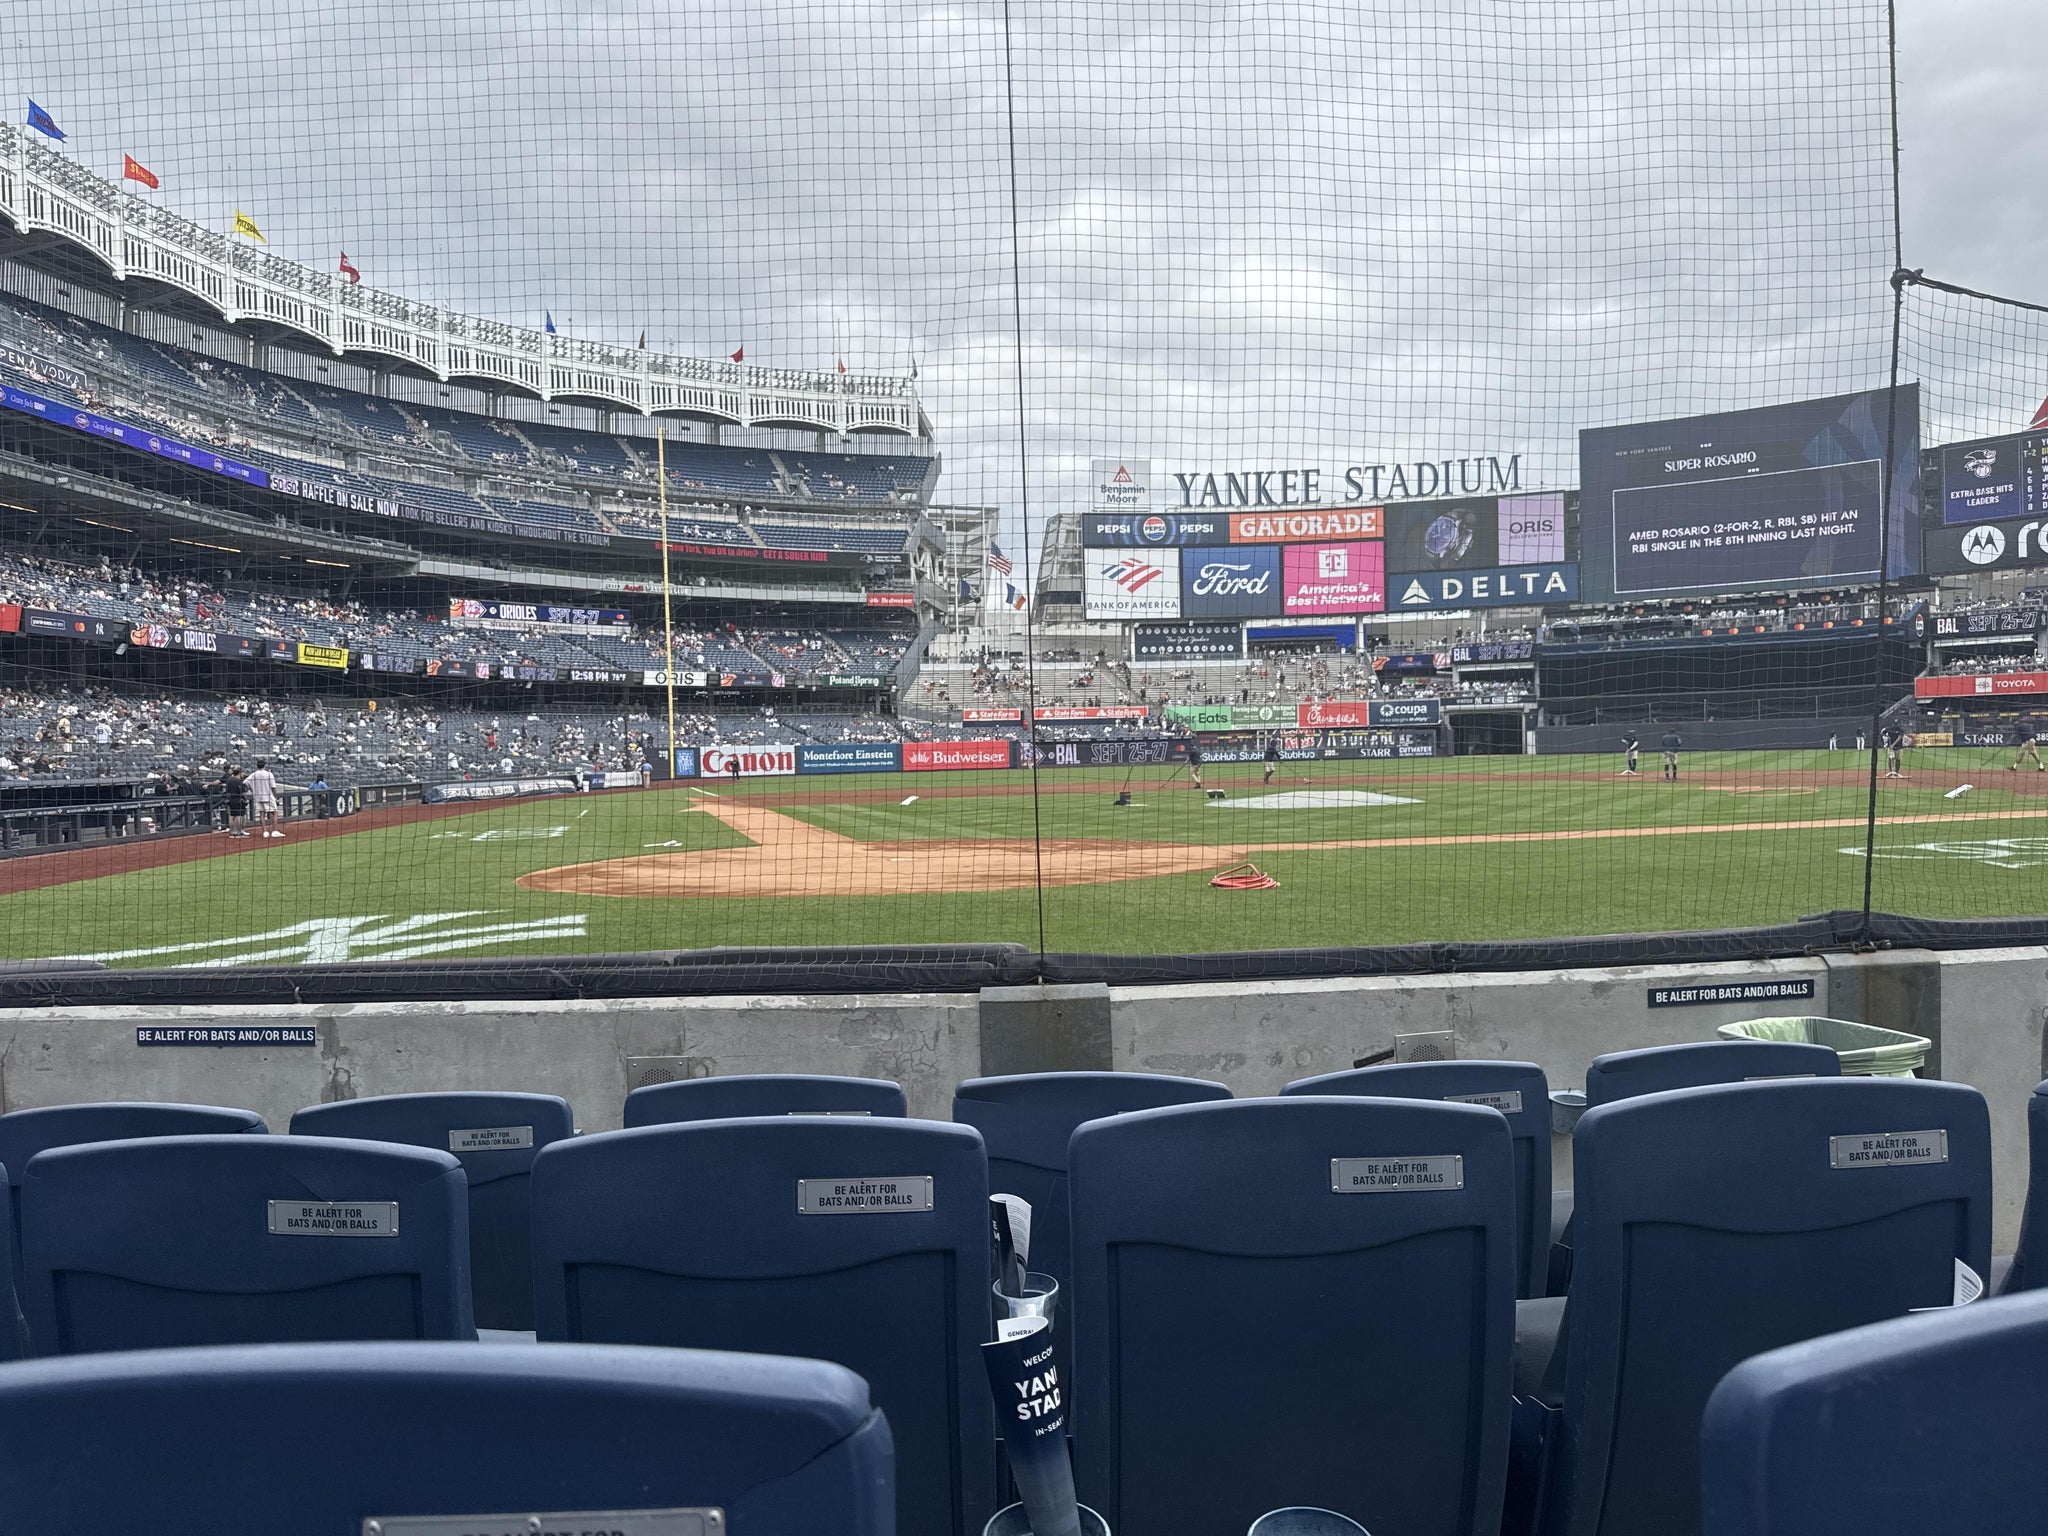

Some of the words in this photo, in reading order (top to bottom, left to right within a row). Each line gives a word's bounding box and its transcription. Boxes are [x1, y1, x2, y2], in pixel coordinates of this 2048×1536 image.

[1665, 458, 1701, 472] SUPER
[1705, 451, 1757, 468] ROSARIO
[2027, 467, 2032, 475] 4
[1173, 468, 1321, 507] YANKEE
[1345, 455, 1521, 501] STADIUM
[2027, 476, 2032, 484] 5
[1101, 484, 1145, 497] Benjamin
[1951, 489, 1974, 499] EXTRA
[1975, 486, 1995, 496] BASE
[1996, 484, 2013, 494] HITS
[2027, 485, 2033, 493] 6
[302, 482, 334, 504] RAFFLE
[337, 490, 349, 508] ON
[351, 494, 374, 513] SALE
[377, 499, 399, 517] NOW
[1106, 495, 1138, 504] Moore
[1966, 495, 2000, 507] LEADERS
[401, 505, 419, 520] LOOK
[421, 511, 434, 523] FOR
[436, 513, 468, 528] SELLERS
[471, 518, 485, 531] AND
[488, 521, 513, 535] KIOSKS
[515, 524, 562, 542] THROUGHOUT
[564, 533, 578, 543] THE
[579, 534, 610, 547] STADIUM
[1097, 524, 1130, 534] PEPSI
[1180, 523, 1213, 533] PEPSI
[1239, 512, 1377, 537] GATORADE
[1510, 519, 1553, 534] ORIS
[1628, 529, 1659, 541] AMED
[1662, 524, 1710, 538] ROSARIO
[1713, 519, 1761, 534] (2-FOR-2,
[1778, 516, 1797, 529] RBI,
[1800, 513, 1817, 526] SB)
[1821, 511, 1838, 522] HIT
[1840, 509, 1858, 520] AN
[1632, 543, 1648, 553] RBI
[1651, 539, 1687, 552] SINGLE
[1690, 538, 1701, 548] IN
[1704, 536, 1722, 547] THE
[1725, 534, 1744, 546] 8TH
[1747, 531, 1787, 545] INNING
[1790, 528, 1816, 540] LAST
[1819, 523, 1855, 536] NIGHT.
[763, 550, 777, 560] GET
[1192, 563, 1271, 595] Ford
[1298, 582, 1369, 595] America's
[1442, 571, 1567, 600] DELTA
[1087, 602, 1115, 610] BANK
[1117, 602, 1130, 610] OF
[1131, 600, 1177, 610] AMERICA
[1287, 595, 1318, 606] Best
[1320, 592, 1380, 605] Network
[500, 604, 537, 621] ORIOLES
[549, 607, 571, 624] SEPT
[573, 609, 600, 625] 25-27
[1937, 618, 1959, 634] BAL
[1968, 614, 1998, 633] SEPT
[2001, 611, 2037, 629] 25-27
[184, 631, 217, 652] ORIOLES
[1453, 648, 1471, 661] BAL
[1479, 646, 1502, 660] SEPT
[1504, 644, 1532, 660] 25-27
[571, 670, 593, 681] 12:58
[596, 671, 608, 682] PM
[655, 672, 694, 685] ORIS
[829, 675, 855, 686] Poland
[855, 676, 879, 687] Spring
[1995, 680, 2036, 688] TOYOTA
[979, 711, 998, 719] State
[1106, 709, 1124, 717] State
[1124, 708, 1141, 716] Farm
[1394, 704, 1427, 716] coupa
[1198, 713, 1228, 724] Eats
[1964, 733, 2004, 744] STARR
[804, 750, 853, 761] Montefiore
[855, 749, 894, 760] Einstein
[932, 752, 1005, 764] Budweiser
[1056, 744, 1080, 764] BAL
[1091, 744, 1124, 764] SEPT
[1128, 742, 1168, 762] 25-27
[1202, 753, 1236, 762] StubHub
[1239, 751, 1264, 760] StubH
[1280, 751, 1315, 759] StubHub
[1360, 748, 1390, 757] STARR
[702, 750, 793, 774] Canon
[1656, 992, 1668, 1003] BE
[1670, 989, 1697, 1001] ALERT
[1699, 988, 1717, 999] FOR
[1718, 986, 1742, 998] BATS
[1742, 984, 1778, 997] AND/OR
[1780, 983, 1808, 995] BALLS
[139, 1030, 152, 1041] BE
[154, 1030, 185, 1041] ALERT
[188, 1030, 207, 1041] FOR
[210, 1030, 236, 1041] BATS
[238, 1030, 280, 1041] AND/OR
[282, 1030, 314, 1041] BALLS
[1863, 1141, 1874, 1150] BE
[1876, 1139, 1900, 1149] ALERT
[1902, 1138, 1917, 1148] FOR
[1849, 1152, 1870, 1161] BATS
[1871, 1150, 1906, 1162] AND/OR
[1907, 1148, 1931, 1158] BALLS
[1368, 1164, 1379, 1174] BE
[1382, 1163, 1408, 1173] ALERT
[1411, 1163, 1428, 1172] FOR
[1352, 1175, 1375, 1185] BATS
[1378, 1174, 1414, 1185] AND/OR
[1416, 1173, 1443, 1183] BALLS
[834, 1185, 846, 1195] BE
[849, 1185, 876, 1194] ALERT
[879, 1184, 897, 1193] FOR
[819, 1197, 842, 1207] BATS
[845, 1195, 882, 1206] AND/OR
[884, 1194, 912, 1205] BALLS
[302, 1208, 314, 1217] BE
[316, 1208, 340, 1217] ALERT
[343, 1208, 362, 1218] FOR
[287, 1218, 310, 1228] BATS
[311, 1218, 347, 1230] AND/OR
[350, 1219, 378, 1229] BALLS
[1008, 1329, 1034, 1337] GENERA
[1023, 1345, 1053, 1368] WELCO
[1014, 1365, 1057, 1399] YAN
[1017, 1387, 1060, 1421] STAD
